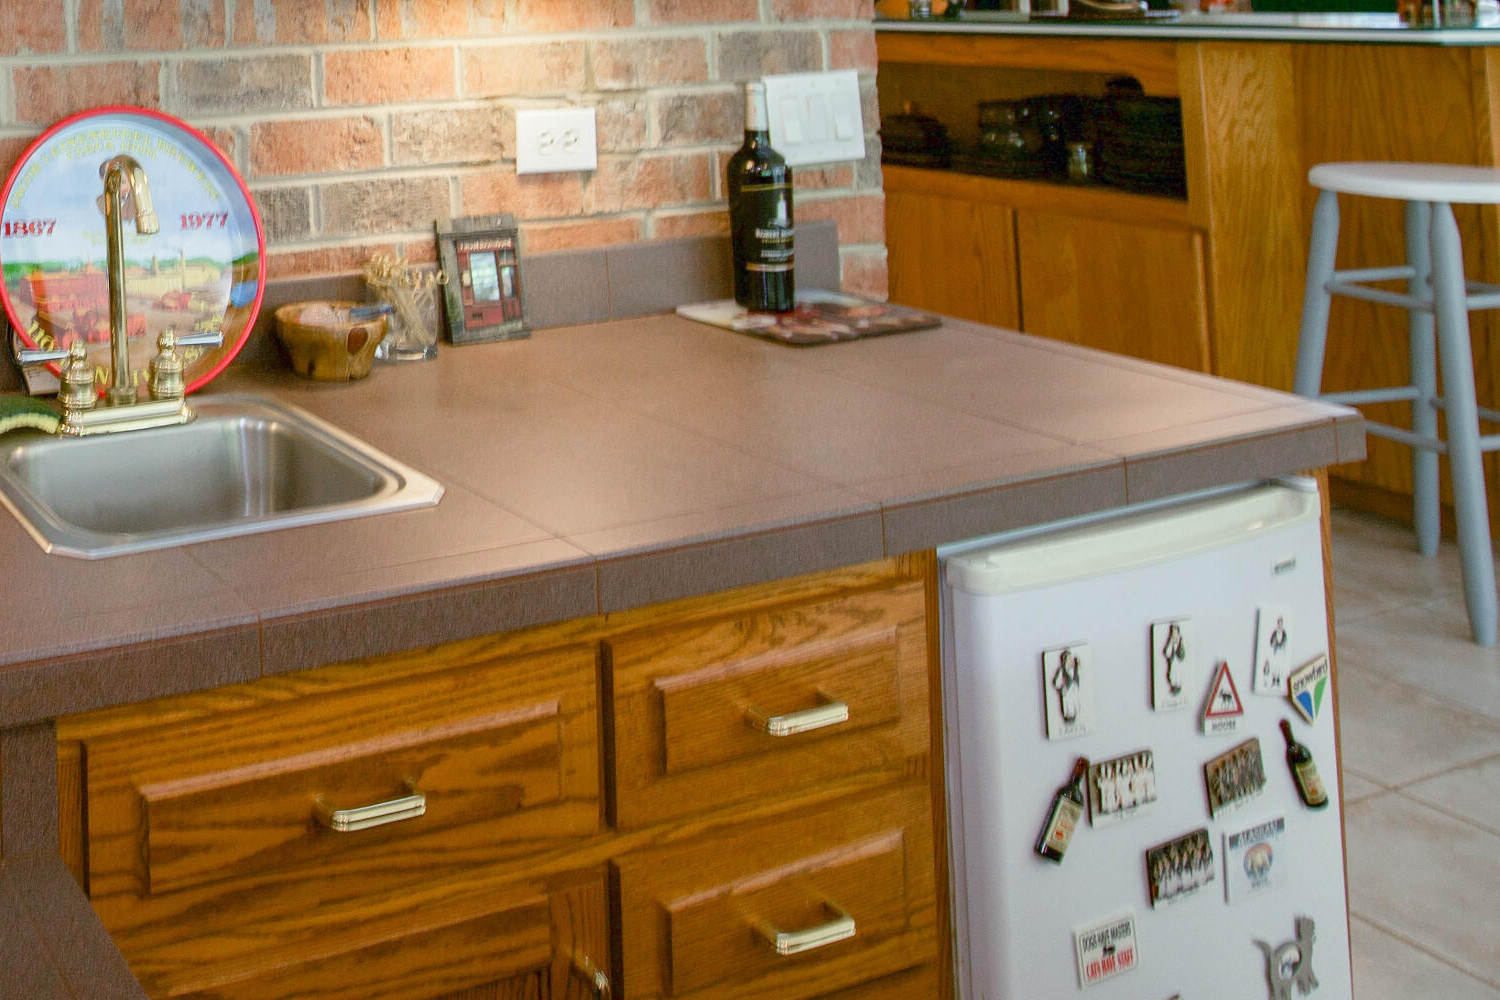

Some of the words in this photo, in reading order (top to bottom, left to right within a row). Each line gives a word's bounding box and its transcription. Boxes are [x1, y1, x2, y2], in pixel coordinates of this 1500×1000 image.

[3, 218, 57, 239] 1867
[179, 211, 229, 231] 1977
[1293, 658, 1328, 691] snowbird
[1211, 719, 1237, 732] MOOSE
[1082, 933, 1097, 954] DOGS
[1097, 927, 1110, 948] HAVE
[1110, 921, 1132, 941] MASTERS
[1086, 960, 1101, 982] CATS
[1101, 954, 1116, 976] HAVE
[1117, 947, 1133, 969] STAFF
